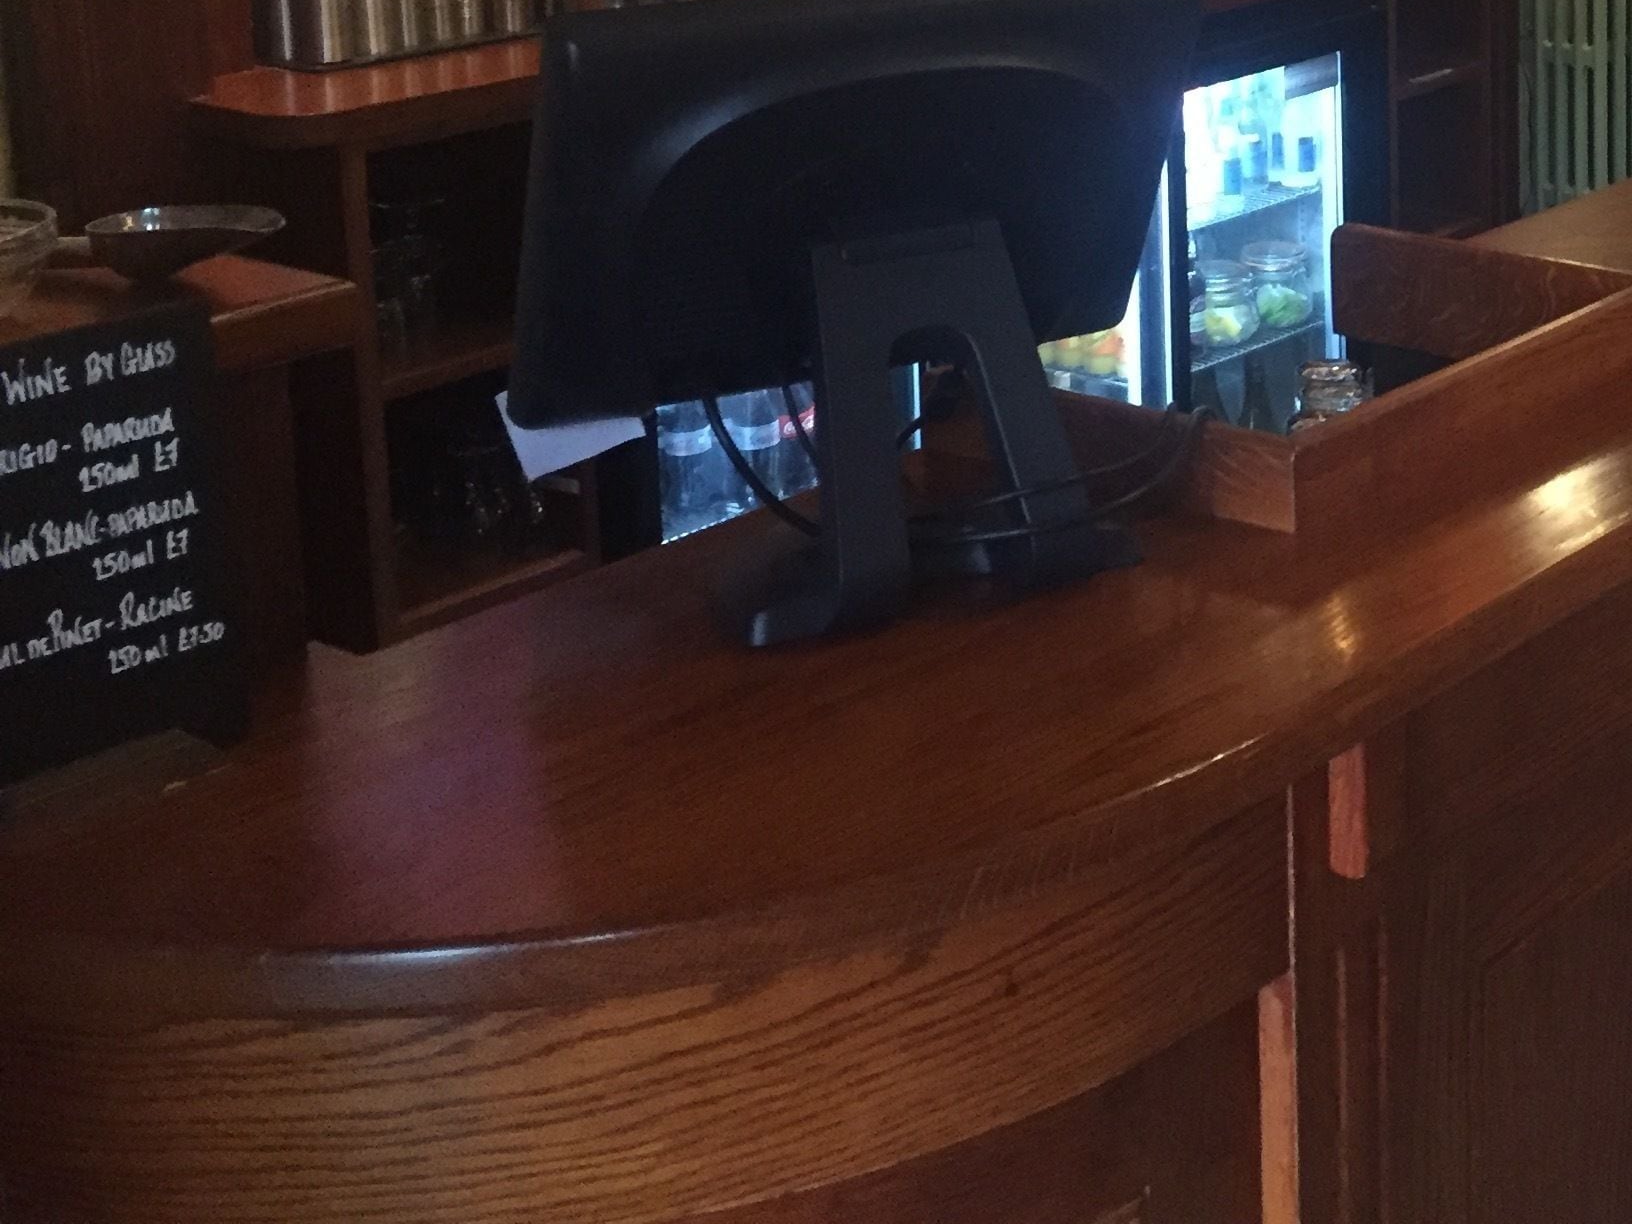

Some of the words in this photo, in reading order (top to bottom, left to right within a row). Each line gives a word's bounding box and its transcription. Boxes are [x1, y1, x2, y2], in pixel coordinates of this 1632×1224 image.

[1, 357, 71, 405] WINE
[85, 350, 115, 386] BY
[120, 340, 176, 376] GLASS
